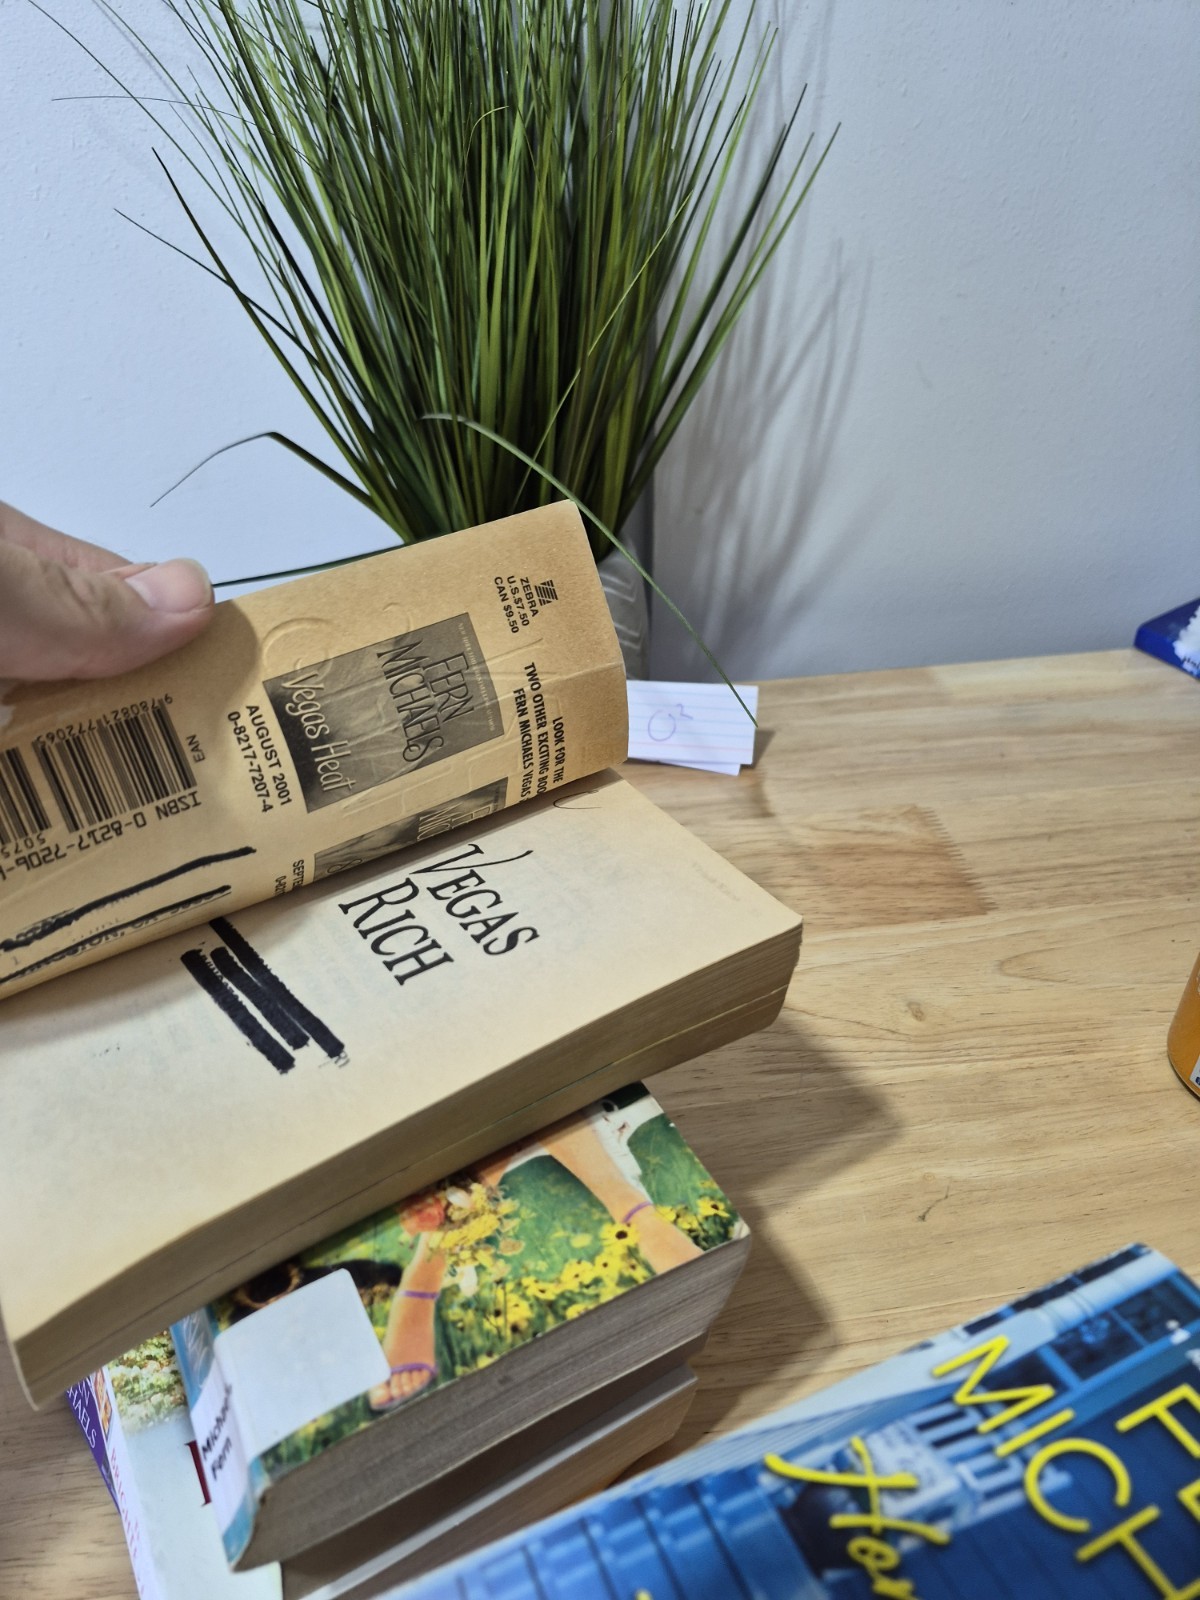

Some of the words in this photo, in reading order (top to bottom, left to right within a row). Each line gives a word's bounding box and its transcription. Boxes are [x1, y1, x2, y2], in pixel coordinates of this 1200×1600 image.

[494, 576, 509, 602] CAN
[503, 603, 520, 634] $9.50
[519, 577, 539, 618] ZEBRA
[422, 652, 475, 722] FERN
[523, 662, 542, 692] TWO
[376, 638, 445, 763] MICHAELS
[513, 688, 529, 718] FERN
[532, 693, 548, 731] OTHER
[186, 734, 206, 763] EAN
[281, 670, 330, 739] Vegas
[311, 740, 357, 791] Heat
[518, 718, 534, 771] MICHAELS
[552, 716, 565, 745] LOOK
[227, 711, 274, 813] 0-8217-7207-4
[245, 704, 282, 769] AUGUST
[272, 773, 293, 806] 2001
[537, 730, 550, 776] EXCITING
[554, 745, 566, 767] FOR
[520, 769, 534, 799] VEGAS
[553, 766, 565, 784] THE
[155, 791, 202, 821] ISBN
[408, 843, 541, 956] VEGAS
[337, 877, 455, 986] RICH
